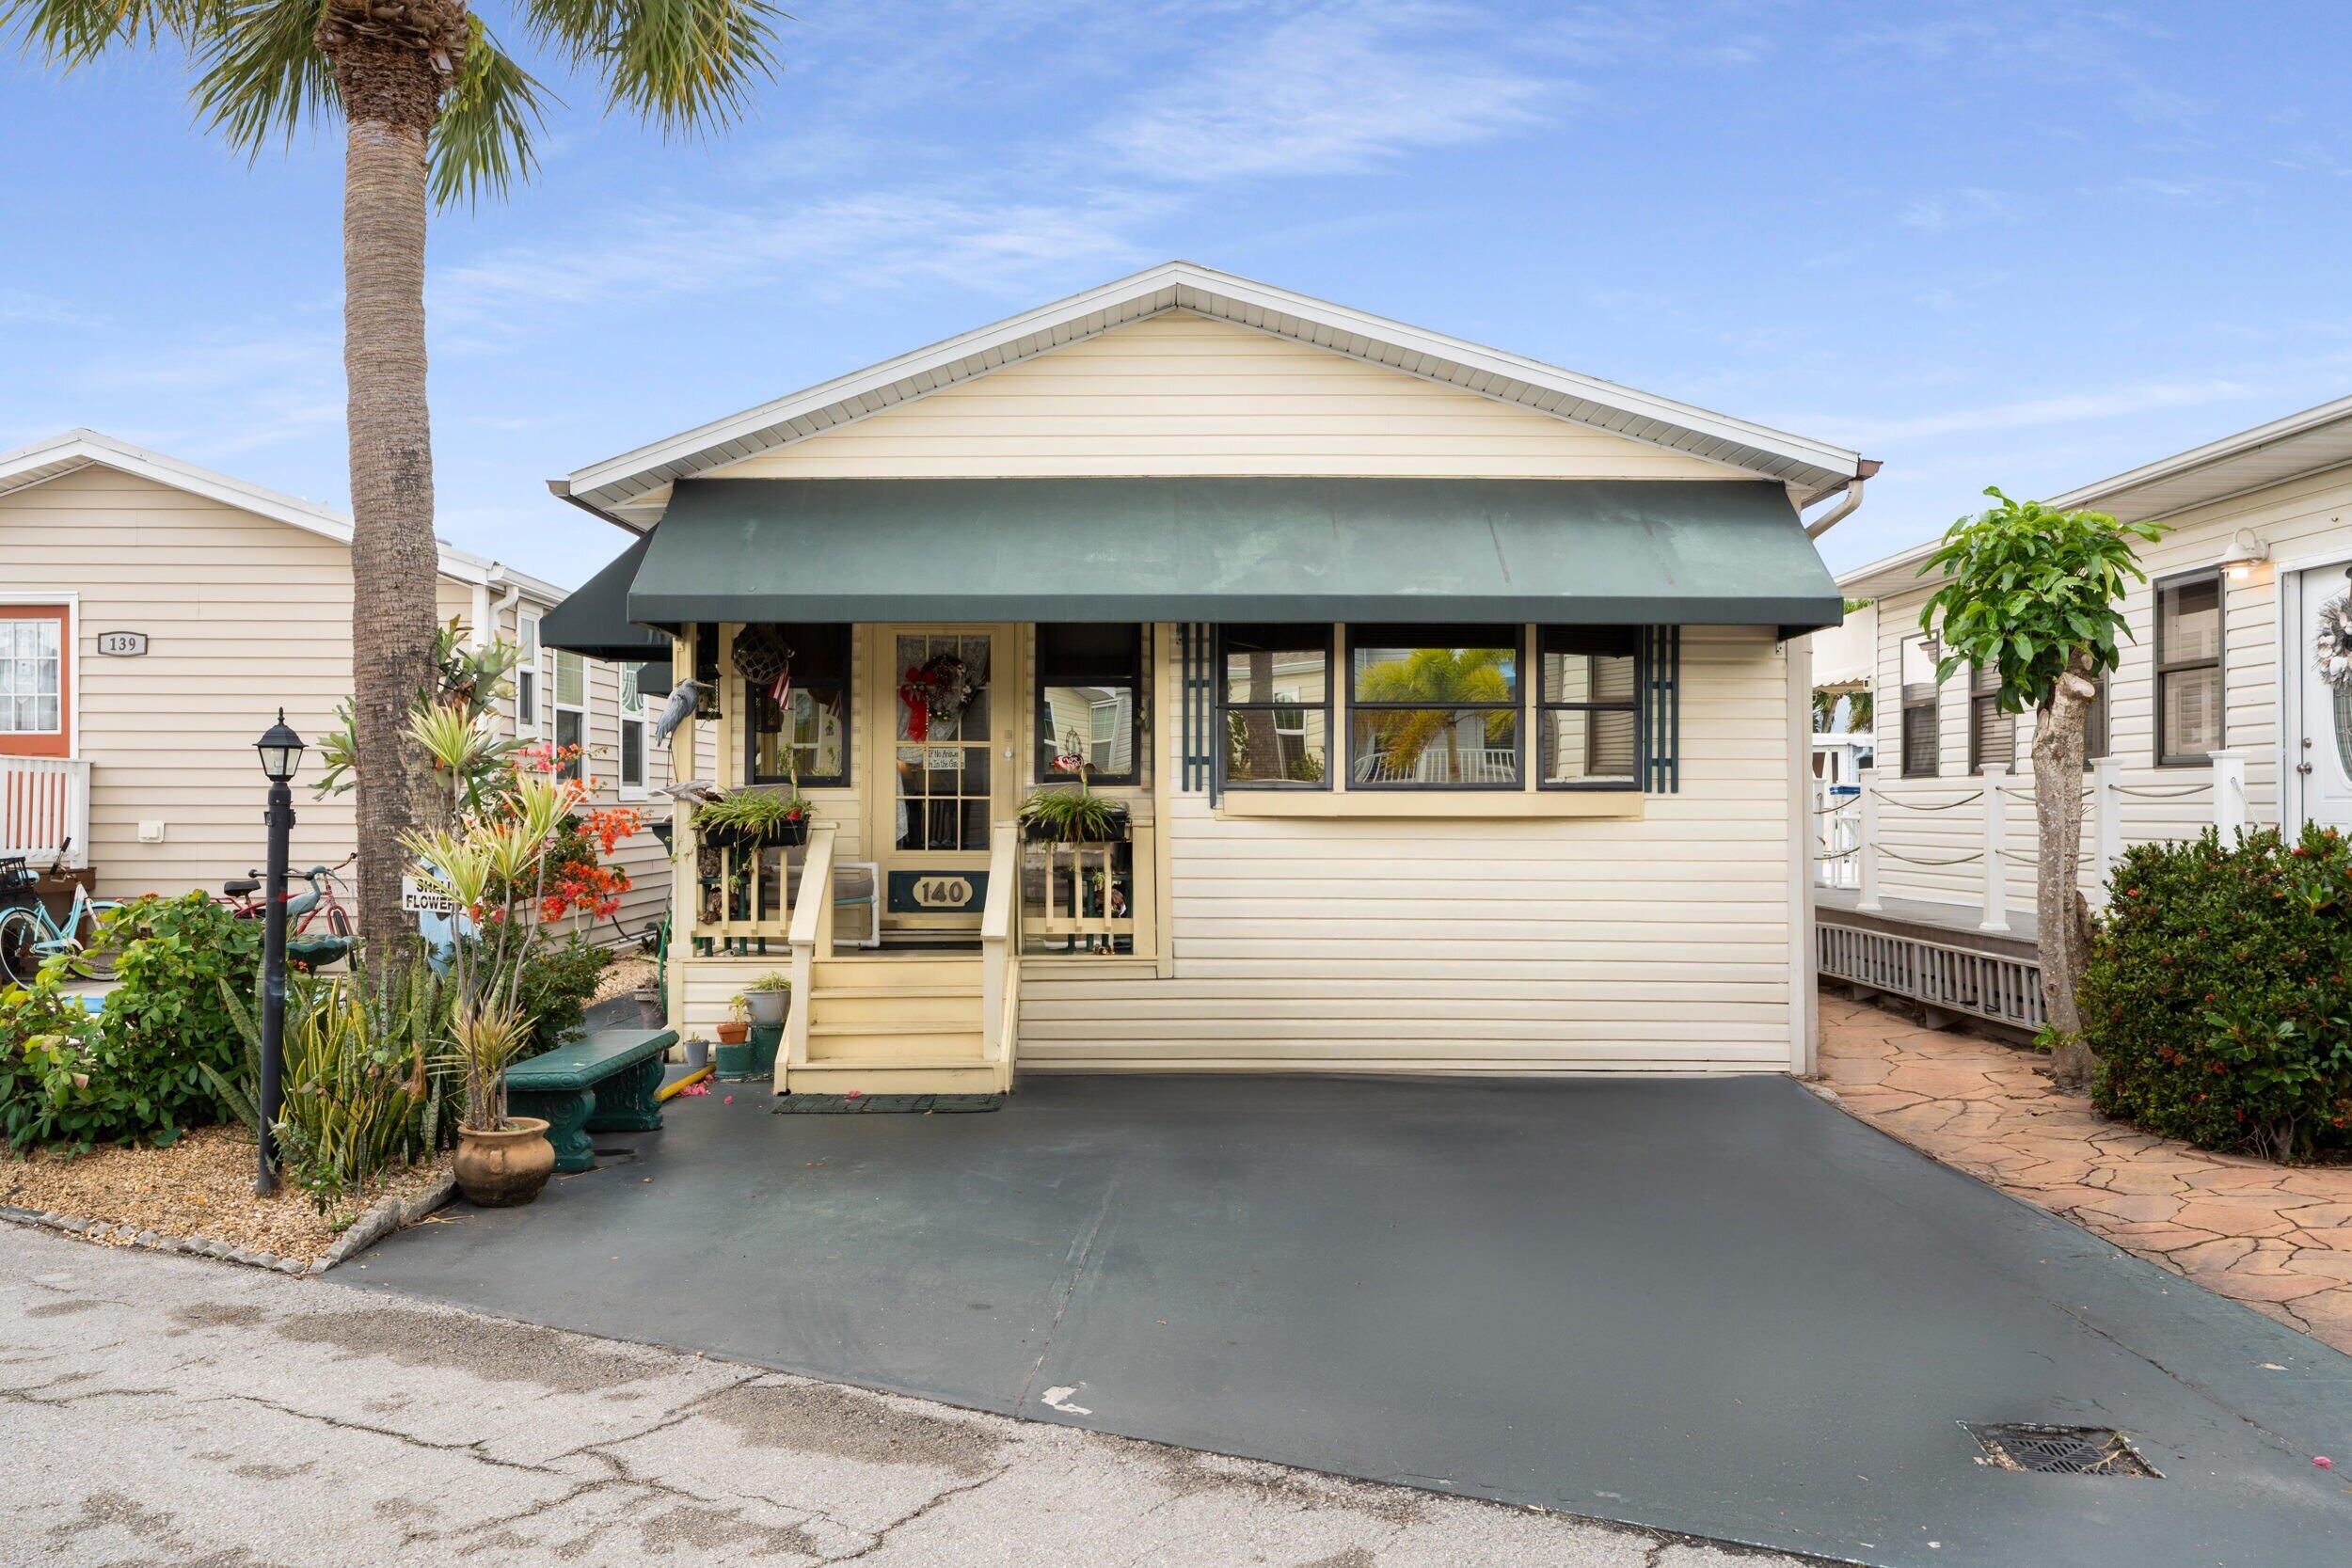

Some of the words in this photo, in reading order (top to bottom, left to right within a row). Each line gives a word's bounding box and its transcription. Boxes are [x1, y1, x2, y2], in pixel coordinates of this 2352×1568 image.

[109, 637, 136, 651] 139
[942, 749, 961, 758] Answe
[922, 880, 964, 903] 140
